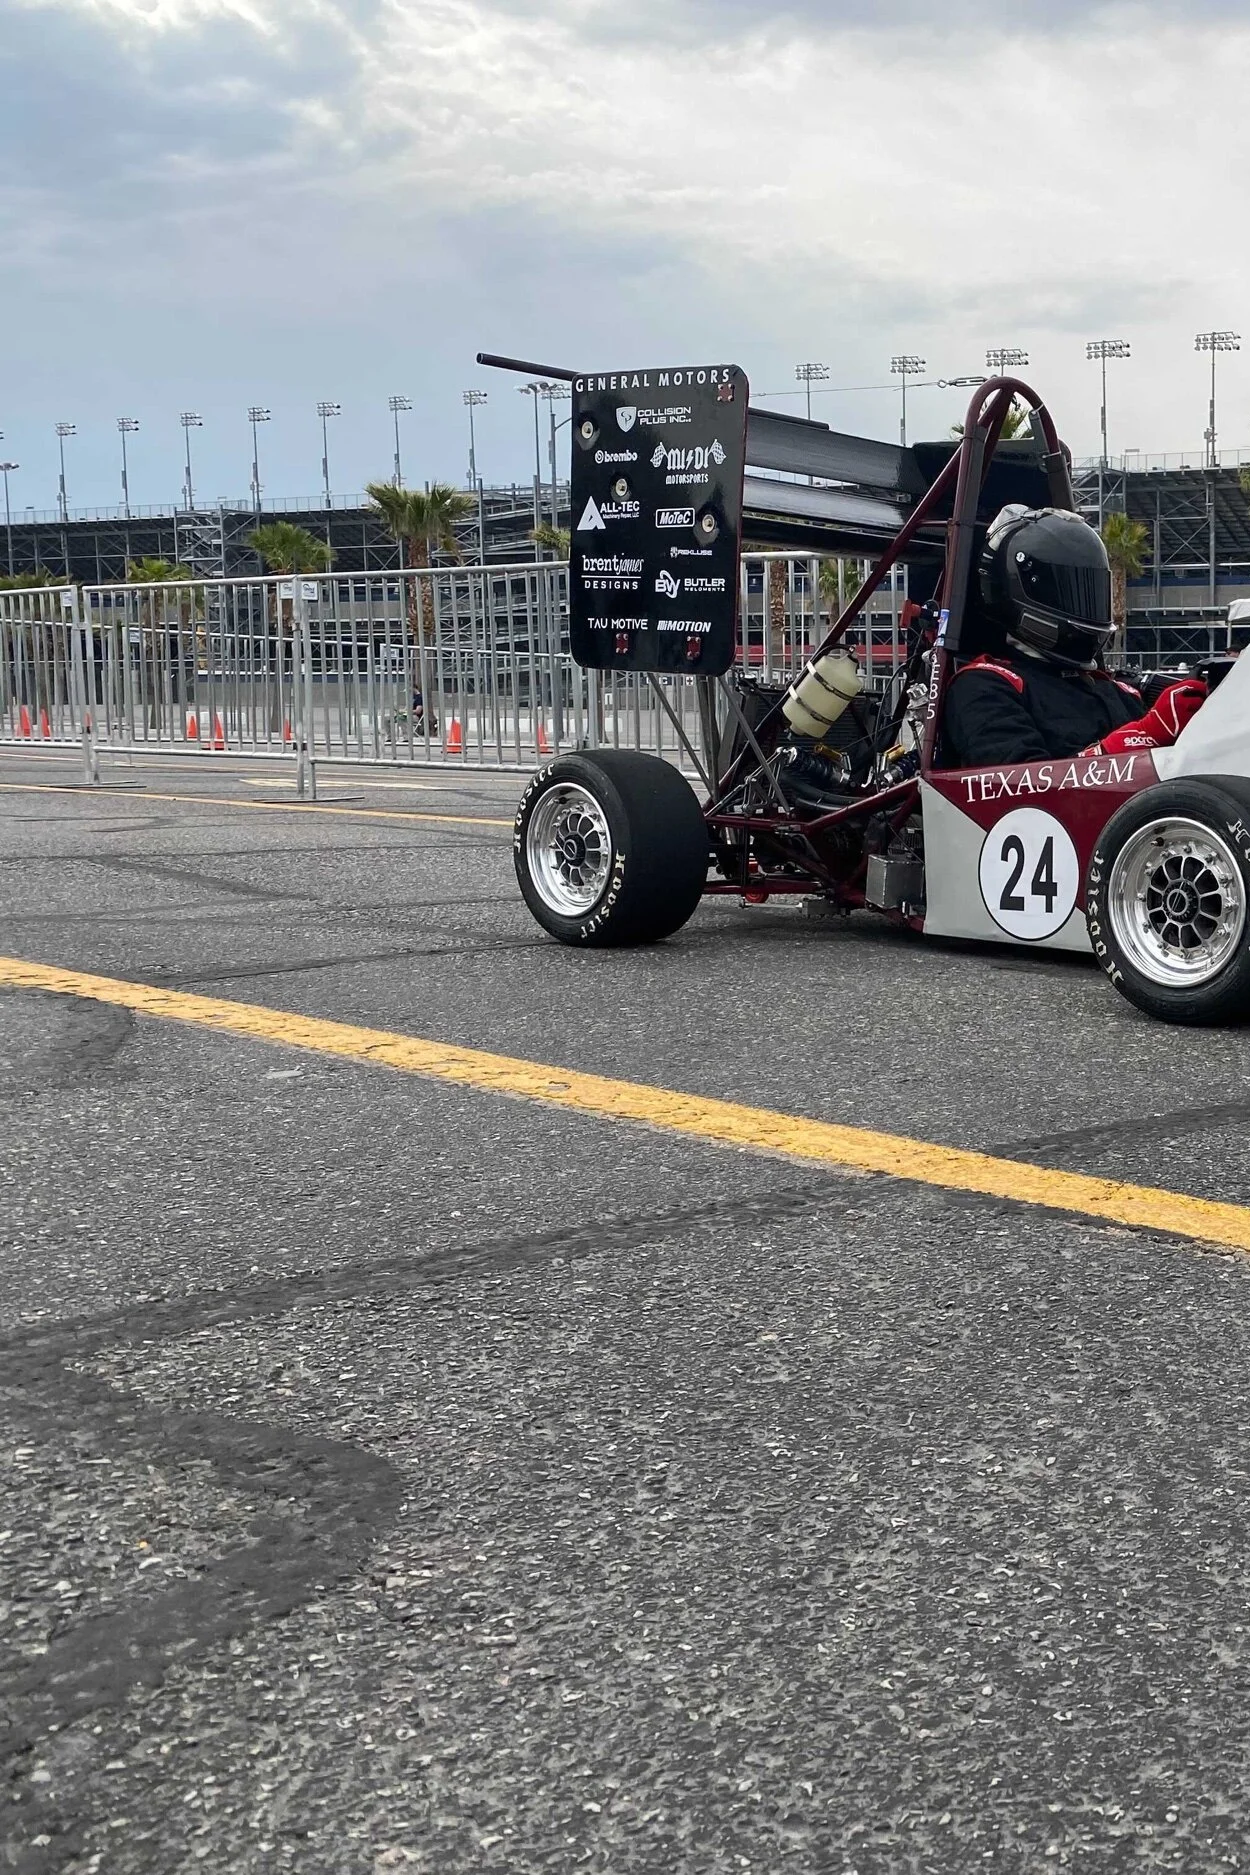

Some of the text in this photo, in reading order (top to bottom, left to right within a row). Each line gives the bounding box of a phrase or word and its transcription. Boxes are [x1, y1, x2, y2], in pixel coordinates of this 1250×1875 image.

[575, 368, 730, 393] GENERAL MOTORS
[637, 406, 692, 418] COLLISION
[639, 416, 667, 426] PLUS
[604, 449, 638, 462] brembo
[665, 473, 709, 485] MOTORSPORTS
[600, 500, 640, 513] ALL-TEC
[659, 510, 691, 525] MoTeC
[584, 580, 639, 590] DESIGNS
[684, 578, 726, 587] BUTLER
[611, 618, 649, 630] MOTIVE
[960, 755, 1138, 803] TEXAS A&M
[999, 834, 1058, 914] 24
